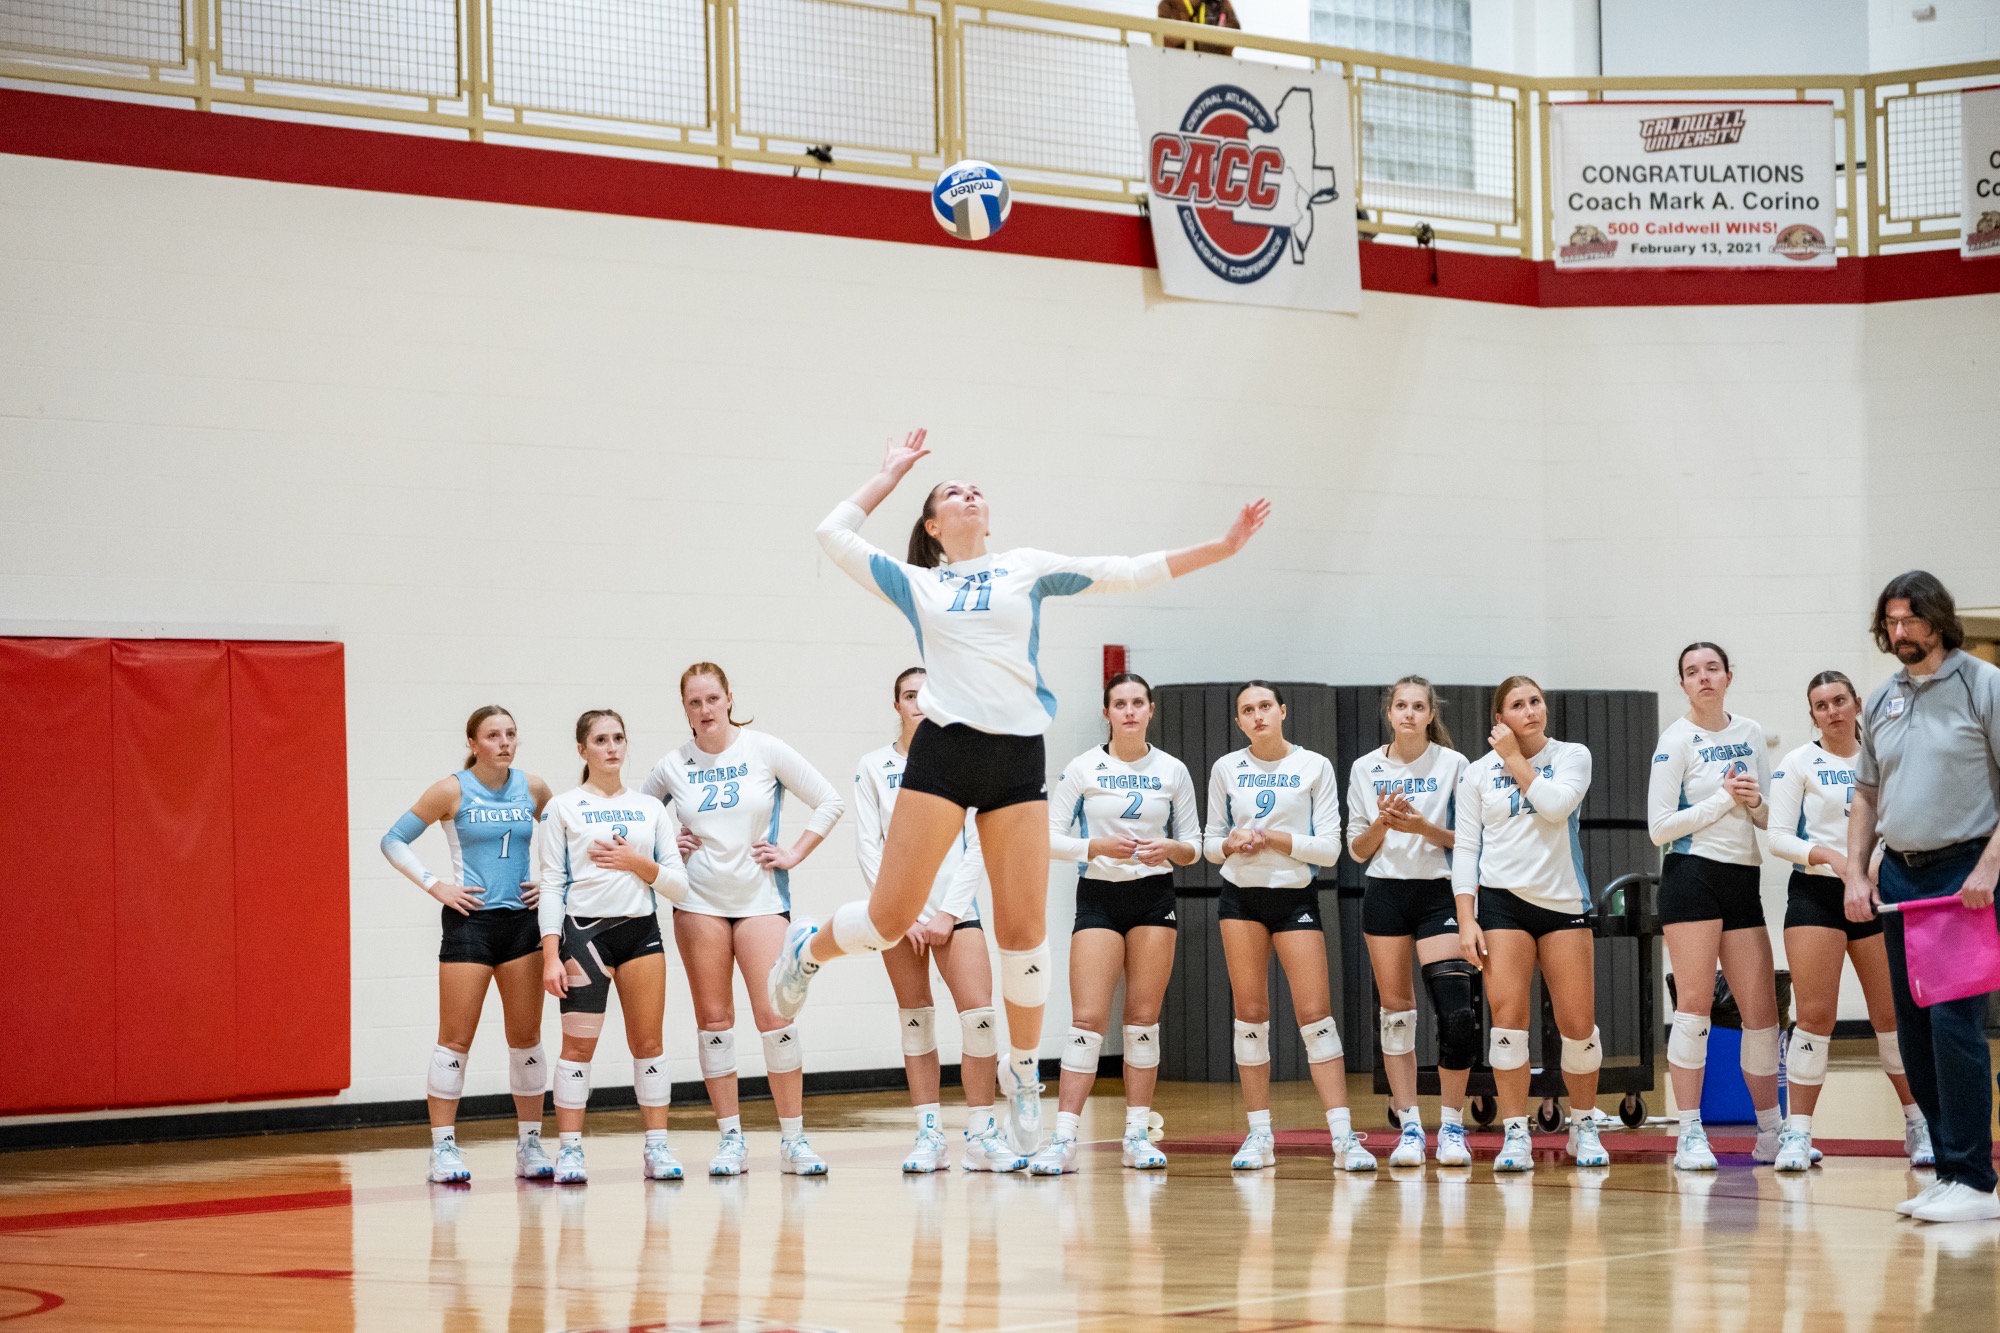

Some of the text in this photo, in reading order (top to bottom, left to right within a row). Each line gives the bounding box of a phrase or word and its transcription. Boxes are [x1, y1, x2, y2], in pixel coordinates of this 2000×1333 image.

[1186, 92, 1266, 130] CENTRAL ATLANTIC
[1645, 127, 1740, 152] UNIVERSITY
[1151, 133, 1285, 210] CACC
[1582, 165, 1804, 184] CONGRATULATIONS
[950, 181, 994, 197] molten
[1568, 192, 1820, 211] Coach Mark A. Corino
[1608, 221, 1778, 235] 500 Caldwell WINS!
[1182, 210, 1282, 278] COLLEGIATE CONFERENCE
[1631, 242, 1696, 257] February
[1702, 242, 1723, 256] 13,
[1726, 242, 1762, 254] 2021
[946, 582, 992, 612] 11
[1698, 742, 1753, 762] TIGERS
[687, 763, 748, 784] TIGERS
[1097, 775, 1162, 790] TIGERS
[1237, 774, 1301, 788] TIGERS
[697, 781, 740, 813] 23
[1373, 778, 1438, 796] TIGERS
[1120, 791, 1144, 820] 2
[1254, 789, 1276, 819] 9
[467, 808, 532, 823] TIGERS
[582, 810, 646, 824] TIGERS
[498, 828, 512, 859] 1
